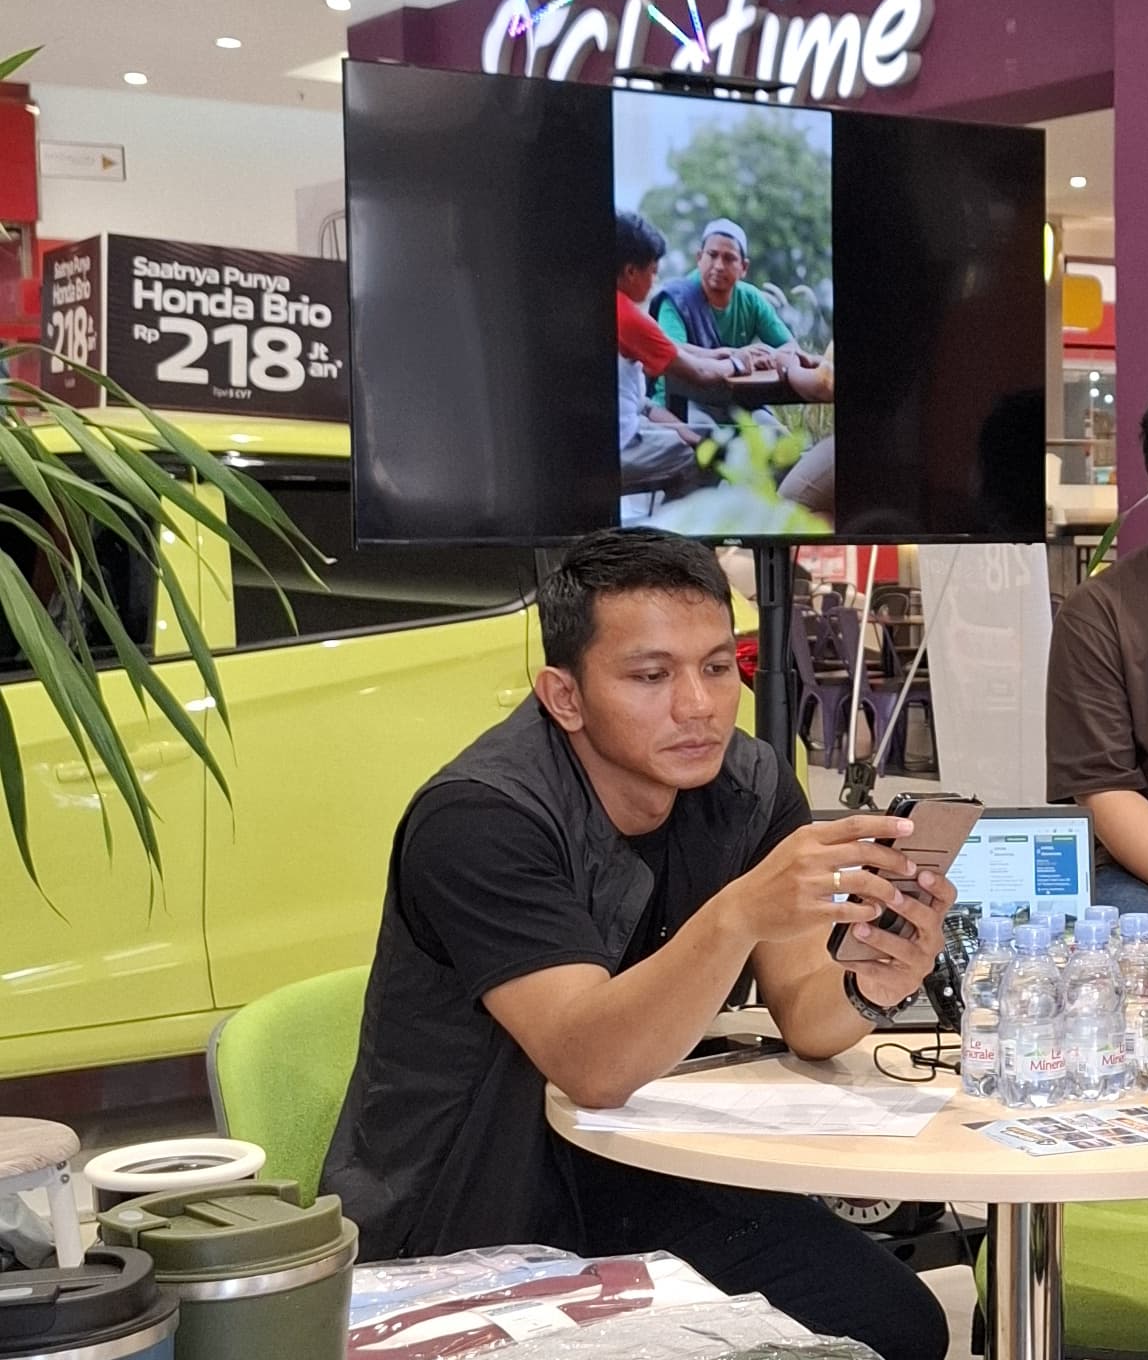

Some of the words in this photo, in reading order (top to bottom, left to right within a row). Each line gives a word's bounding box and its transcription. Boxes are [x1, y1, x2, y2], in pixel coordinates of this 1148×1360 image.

[133, 255, 220, 286] Saatnya
[223, 265, 290, 292] Punya
[133, 278, 254, 321] Honda
[262, 291, 332, 328] Brio
[51, 305, 88, 373] 218
[133, 323, 160, 343] Rp
[157, 316, 305, 392] 218
[308, 341, 329, 361] Jt
[963, 1048, 994, 1060] nerale
[970, 1037, 982, 1049] Le
[1051, 1048, 1061, 1059] Le
